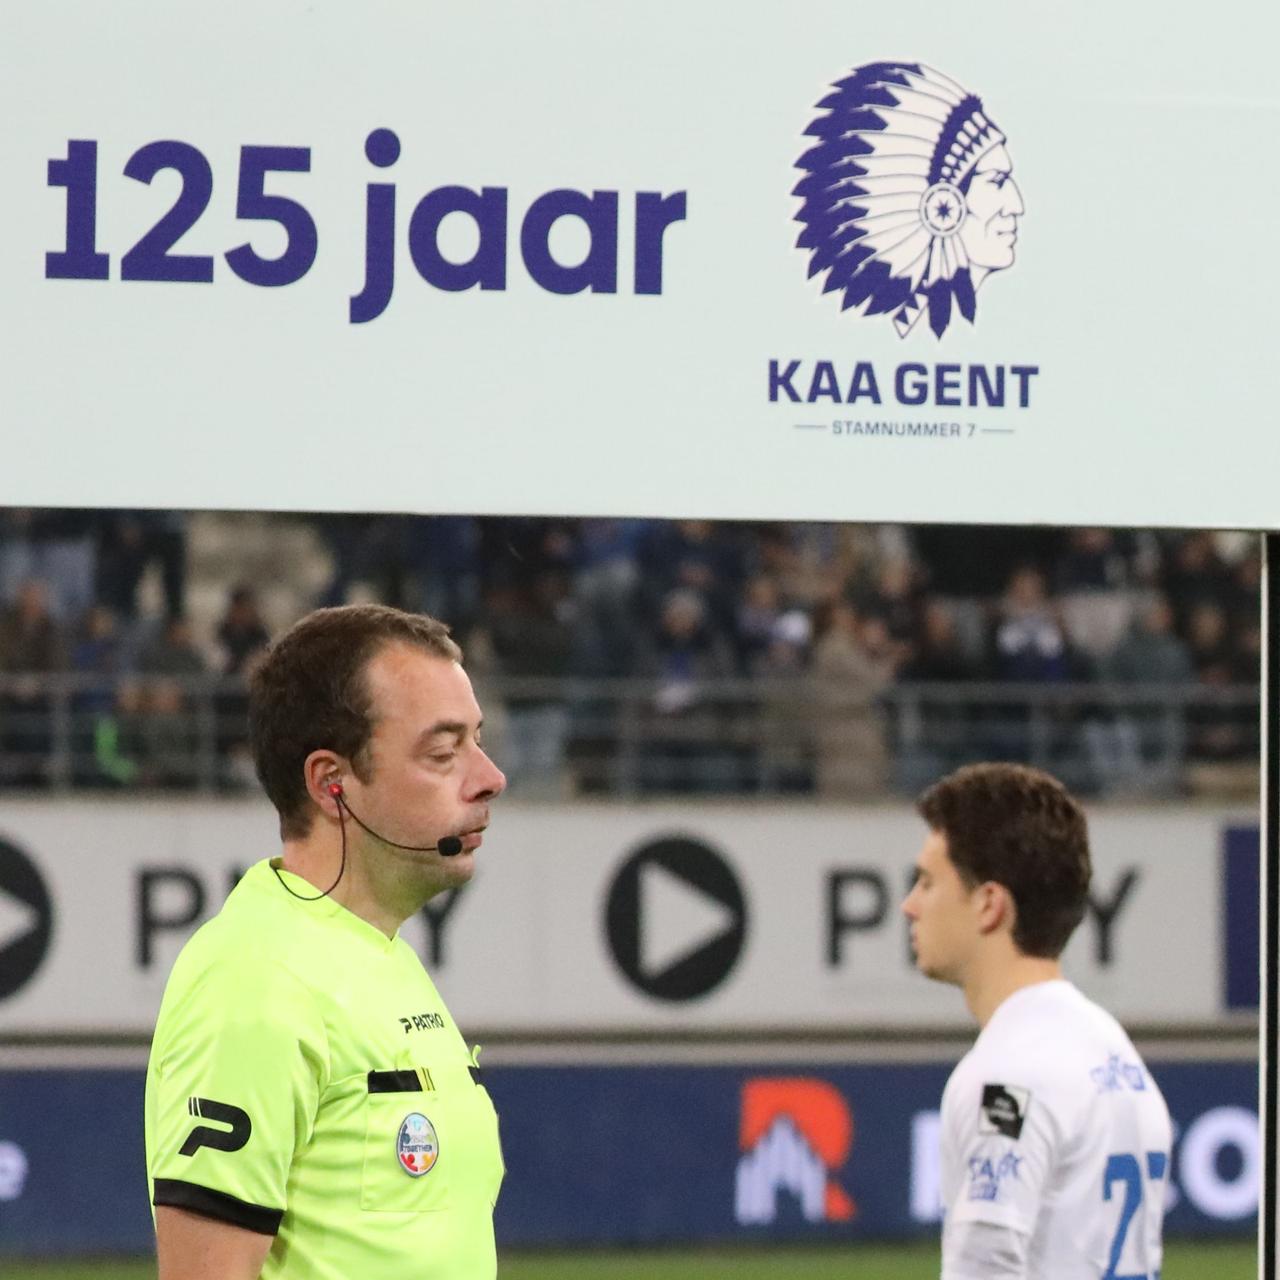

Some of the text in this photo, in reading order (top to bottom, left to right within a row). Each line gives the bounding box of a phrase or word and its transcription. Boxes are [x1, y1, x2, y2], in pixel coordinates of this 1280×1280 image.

[45, 126, 687, 325] 125 jaar
[768, 359, 1039, 408] KAA GENT
[832, 420, 977, 438] STAMNUMMER 7
[136, 865, 463, 968] PY
[826, 864, 1139, 967] PY
